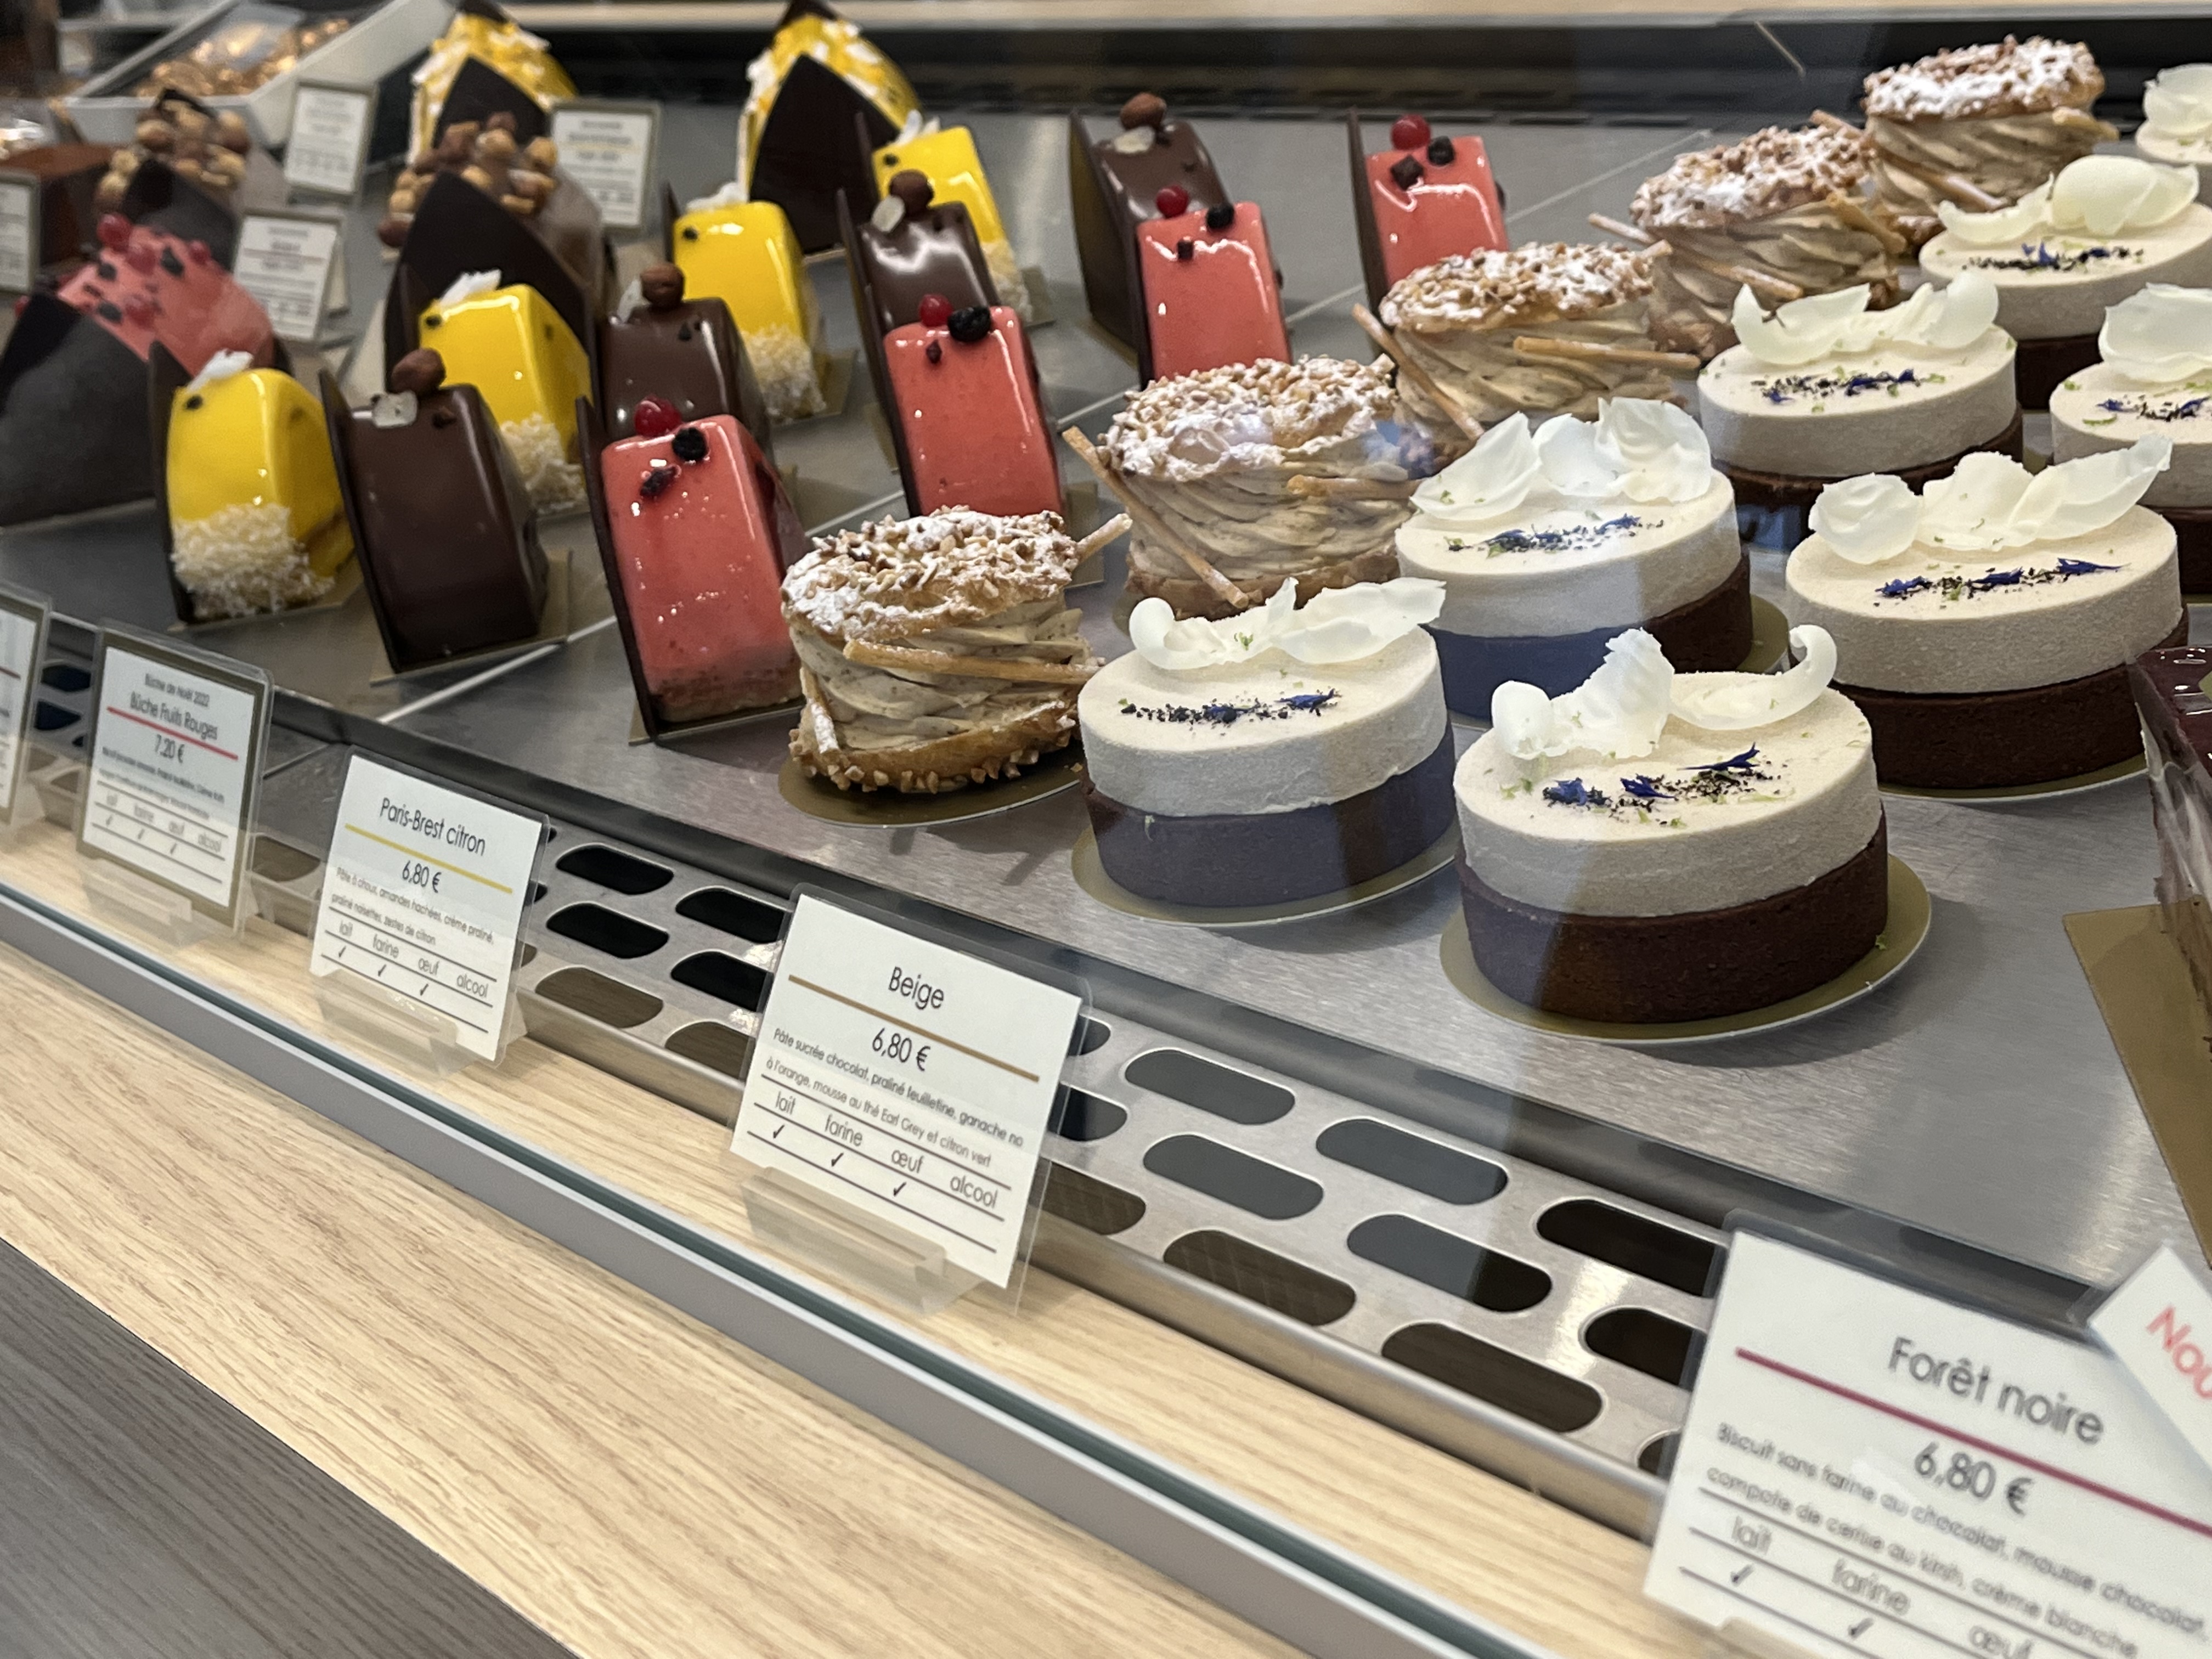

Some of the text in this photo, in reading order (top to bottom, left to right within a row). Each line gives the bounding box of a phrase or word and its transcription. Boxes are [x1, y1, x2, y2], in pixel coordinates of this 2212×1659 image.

[177, 743, 185, 763] €
[184, 712, 218, 741] Rouges
[380, 797, 486, 856] Paris-Brest citron
[402, 860, 442, 893] 6,80 €
[373, 933, 399, 959] farine
[456, 973, 488, 998] alcool
[888, 966, 944, 1010] Beige
[872, 1027, 931, 1071] 6,80 €
[774, 1028, 794, 1047] Pâte
[795, 1040, 825, 1060] sucrée
[871, 1074, 905, 1096] praliné
[960, 1111, 1007, 1140] ganache
[775, 1090, 998, 1208] lait farine œuf alcool
[812, 1080, 847, 1104] mousse
[849, 1096, 862, 1110] au
[863, 1098, 879, 1118] thé
[881, 1108, 900, 1126] Earl
[901, 1117, 925, 1140] Grey
[927, 1130, 939, 1143] et
[940, 1136, 969, 1157] citron
[971, 1150, 991, 1168] vert
[1888, 1336, 2104, 1446] Forêt noire
[1777, 1451, 1818, 1480] sans
[1822, 1463, 1877, 1503] farine
[1880, 1493, 1910, 1517] au
[1915, 1441, 2032, 1516] 6,80 €
[1706, 1467, 1793, 1514] compote
[1795, 1501, 1822, 1527] de
[1972, 1577, 2042, 1620] crème
[1731, 1515, 1773, 1556] lait
[1831, 1558, 1911, 1617] farine
